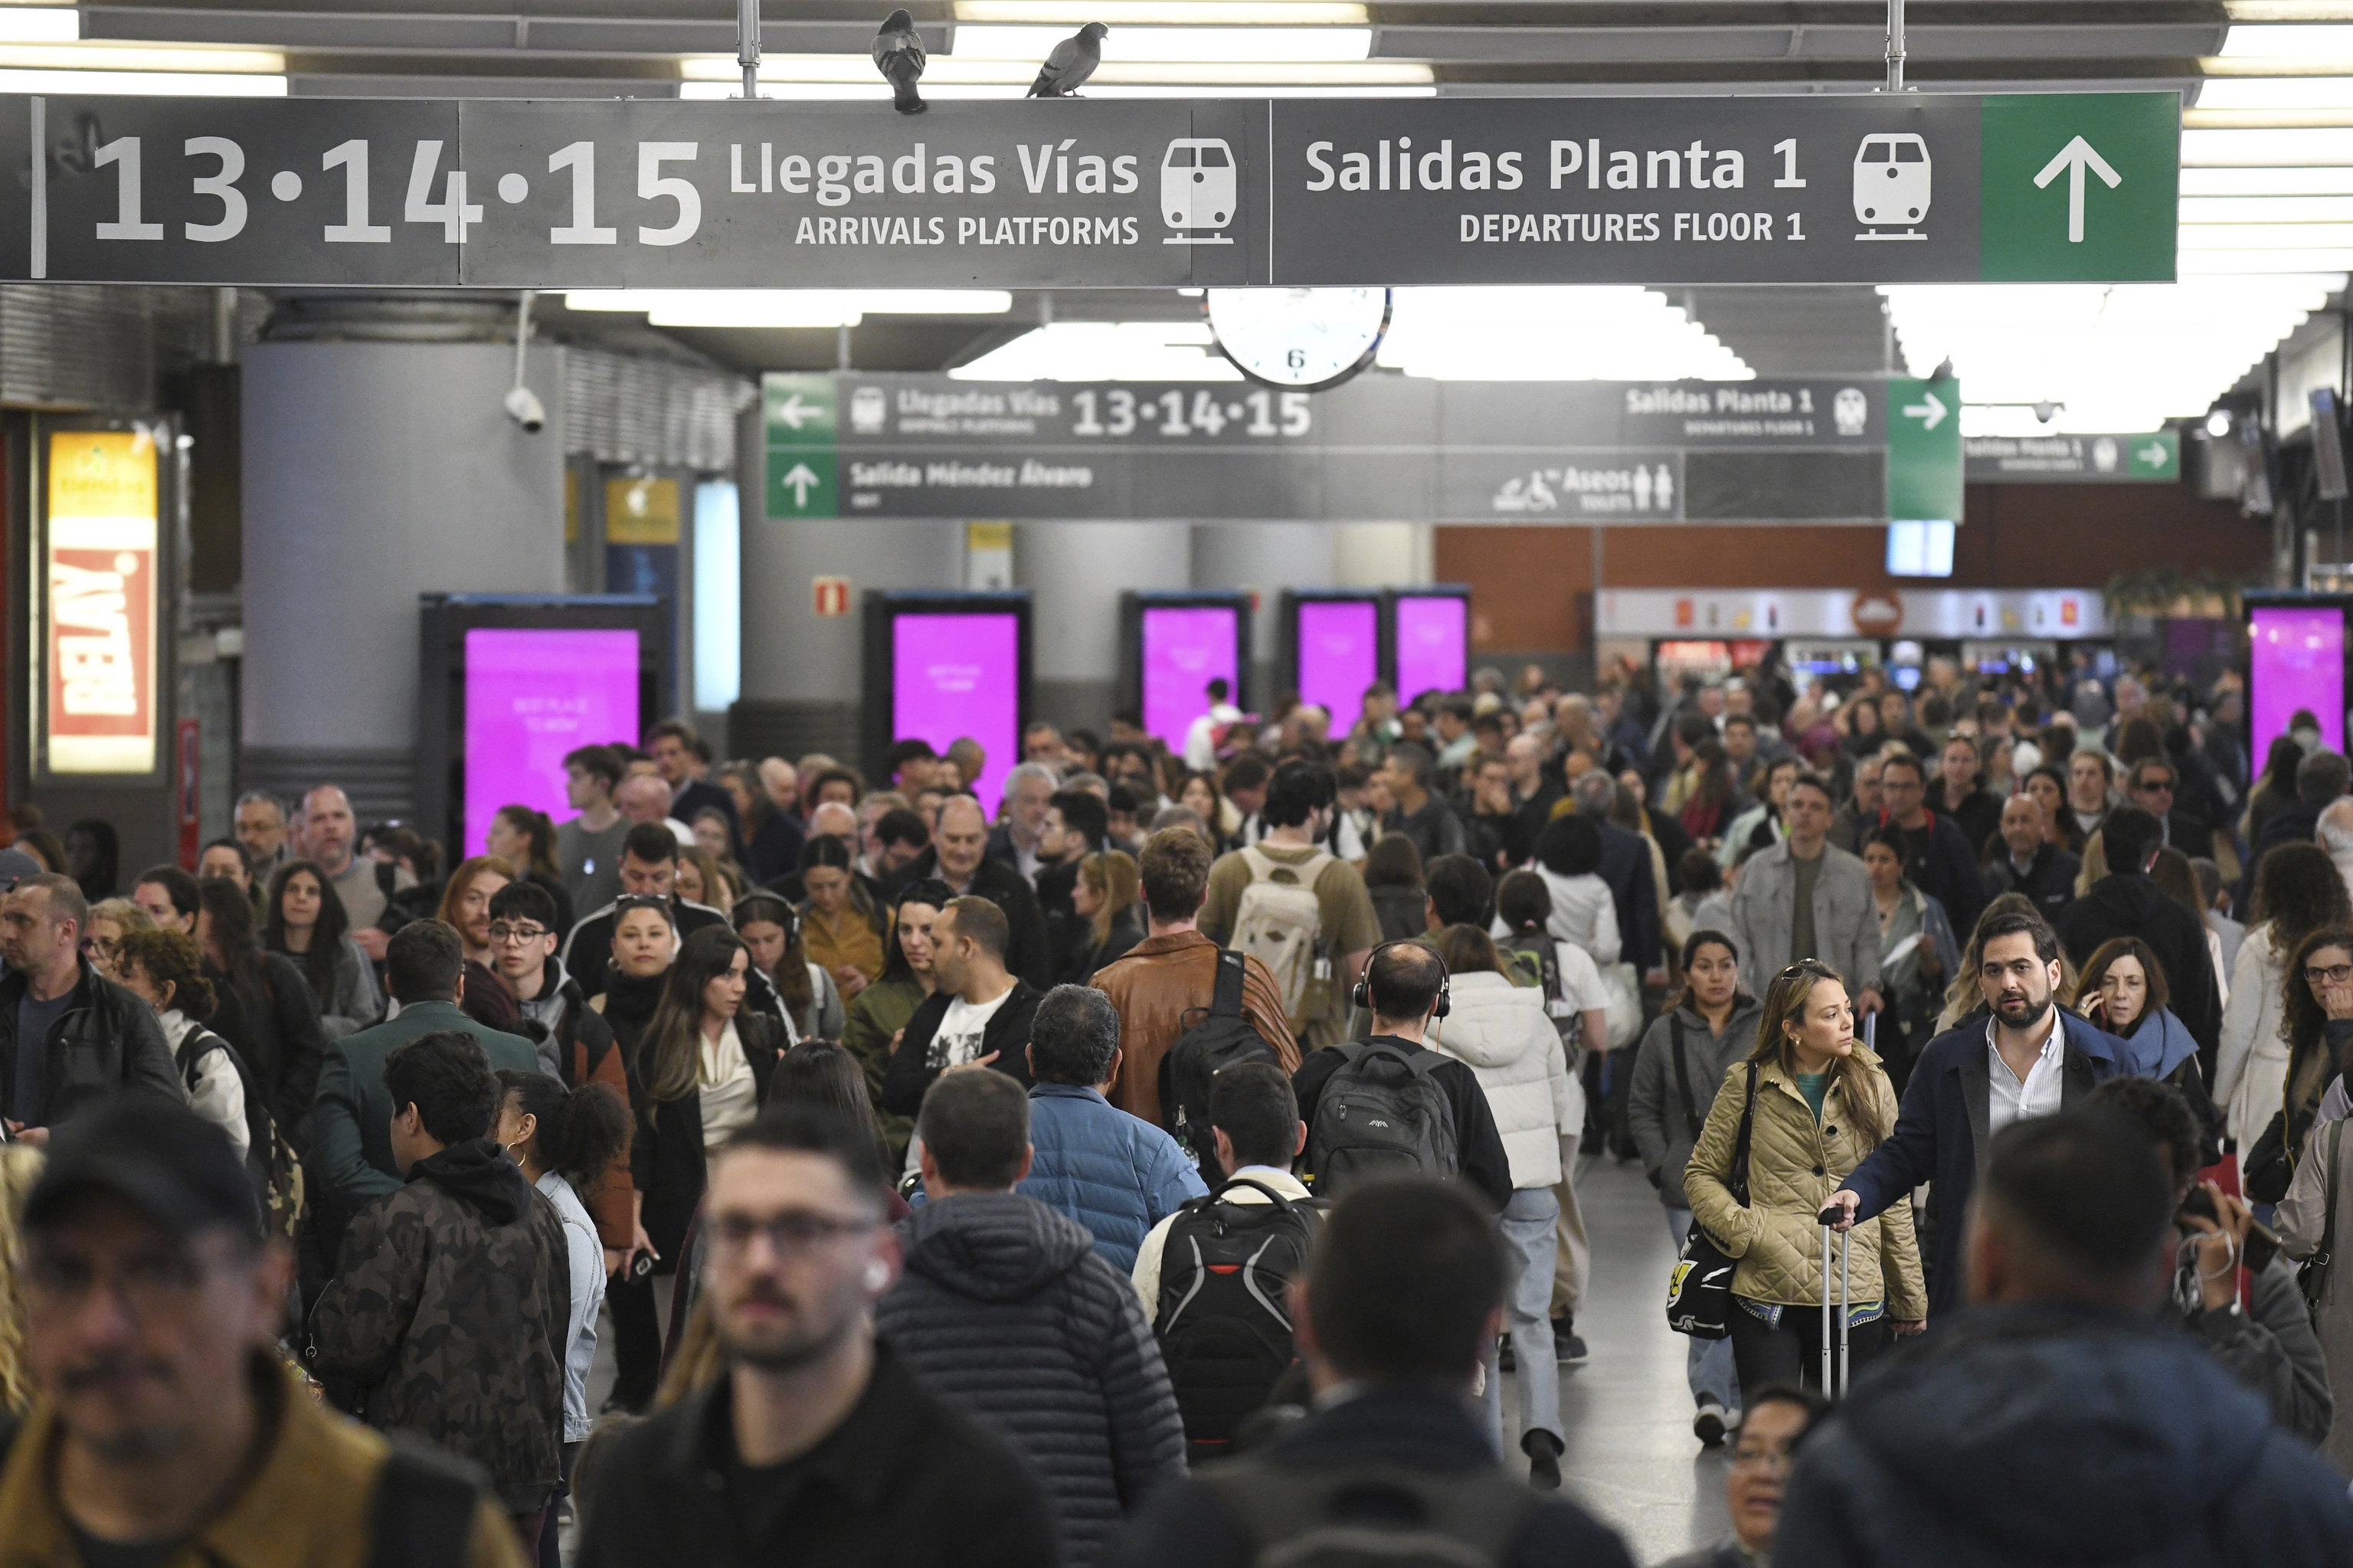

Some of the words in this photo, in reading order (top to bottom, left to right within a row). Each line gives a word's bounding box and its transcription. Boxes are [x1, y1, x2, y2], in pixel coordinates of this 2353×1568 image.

[730, 142, 997, 207] Llegadas
[1016, 139, 1140, 195] Vías
[1305, 136, 1524, 191] Salidas
[1550, 138, 1745, 190] Planta
[1772, 138, 1808, 188] 1
[794, 216, 946, 245] ARRIVALS
[957, 216, 1140, 245] PLATFORMS
[1460, 212, 1661, 243] DEPARTURES
[1674, 212, 1774, 242] FLOOR
[1786, 212, 1806, 241] 1
[1287, 349, 1305, 368] 6
[1626, 388, 1710, 414] Salidas
[1715, 388, 1793, 414] Planta
[1798, 389, 1814, 414] 1
